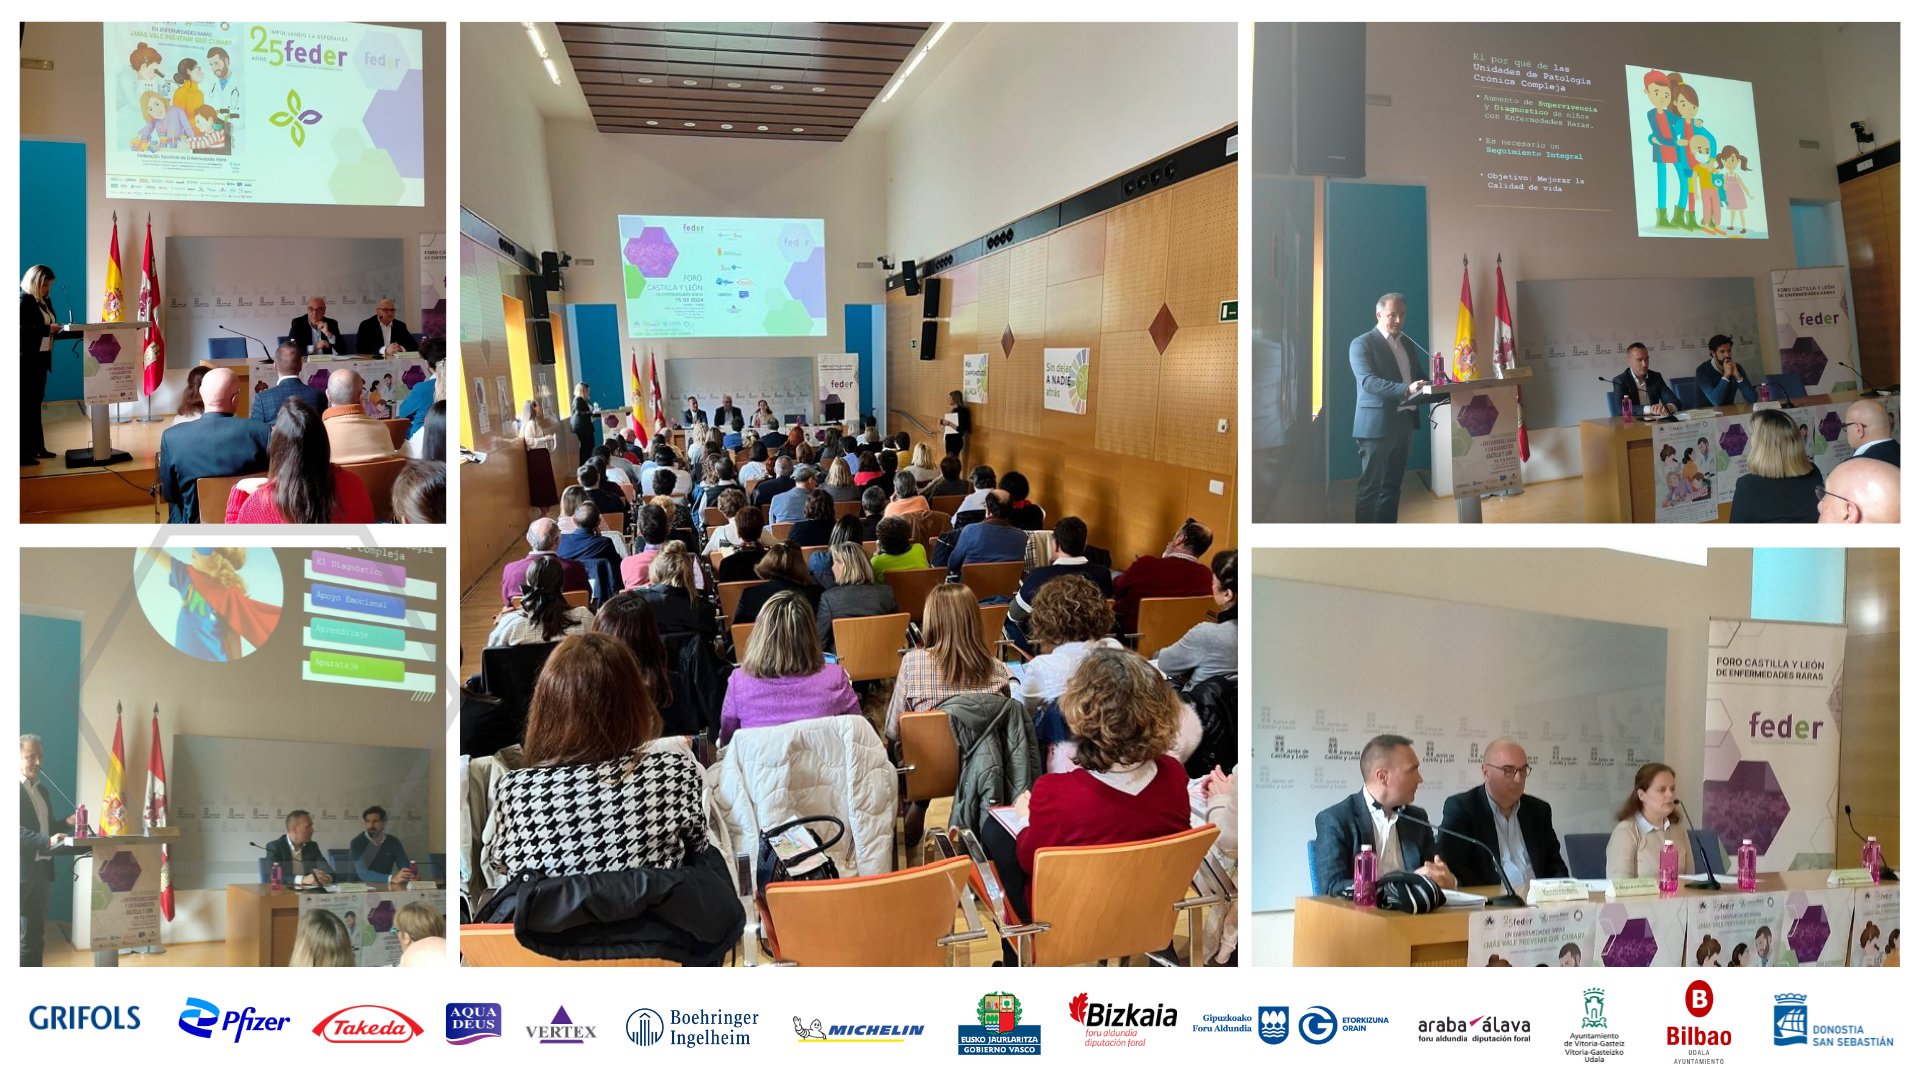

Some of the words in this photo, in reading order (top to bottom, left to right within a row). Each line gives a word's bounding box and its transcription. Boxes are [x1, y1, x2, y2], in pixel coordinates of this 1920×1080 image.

[166, 34, 193, 42] PREVENIR
[270, 29, 306, 38] IMPULSANDO
[317, 34, 349, 42] ESPERANZA
[284, 40, 348, 67] feder
[364, 52, 401, 68] feder
[1515, 60, 1531, 68] qué
[1554, 64, 1570, 72] las
[1473, 64, 1520, 76] Unidades
[1543, 73, 1592, 85] Patología
[1474, 74, 1515, 85] Crónica
[1521, 80, 1566, 92] Compleja
[1484, 95, 1519, 103] Aumento
[1538, 100, 1598, 112] Supervivencia
[1494, 104, 1548, 115] Diagnóstico
[1567, 112, 1589, 120] niños
[1505, 114, 1563, 126] Enfermedades
[1567, 121, 1594, 129] Raras.
[1501, 140, 1546, 149] necesario
[1486, 147, 1541, 157] Seguimiento
[1546, 152, 1583, 160] Integral
[1487, 173, 1532, 181] Objetivo:
[1537, 176, 1571, 184] Mejorar
[1488, 182, 1524, 190] Calidad
[683, 224, 704, 232] feder
[784, 237, 809, 247] fedr
[1799, 312, 1839, 326] feder
[1046, 363, 1055, 372] Sin
[1057, 364, 1071, 374] dejar
[831, 380, 853, 388] feder
[1052, 376, 1071, 386] NADIE
[1046, 388, 1060, 398] atrás
[332, 561, 383, 576] Diagnóstico
[316, 591, 341, 601] Apoyo
[346, 596, 387, 608] Emocional
[315, 625, 369, 639] Aprendizaje
[315, 658, 359, 670] Aparataje
[1716, 657, 1742, 666] FORO
[1745, 658, 1789, 668] CASTILLA
[1801, 659, 1825, 670] LEÓN
[1729, 669, 1794, 679] ENFERMEDADES
[1796, 672, 1824, 680] RARAS
[1749, 711, 1824, 739] feder
[1502, 939, 1517, 947] VALE
[1519, 937, 1548, 946] PREVENIR
